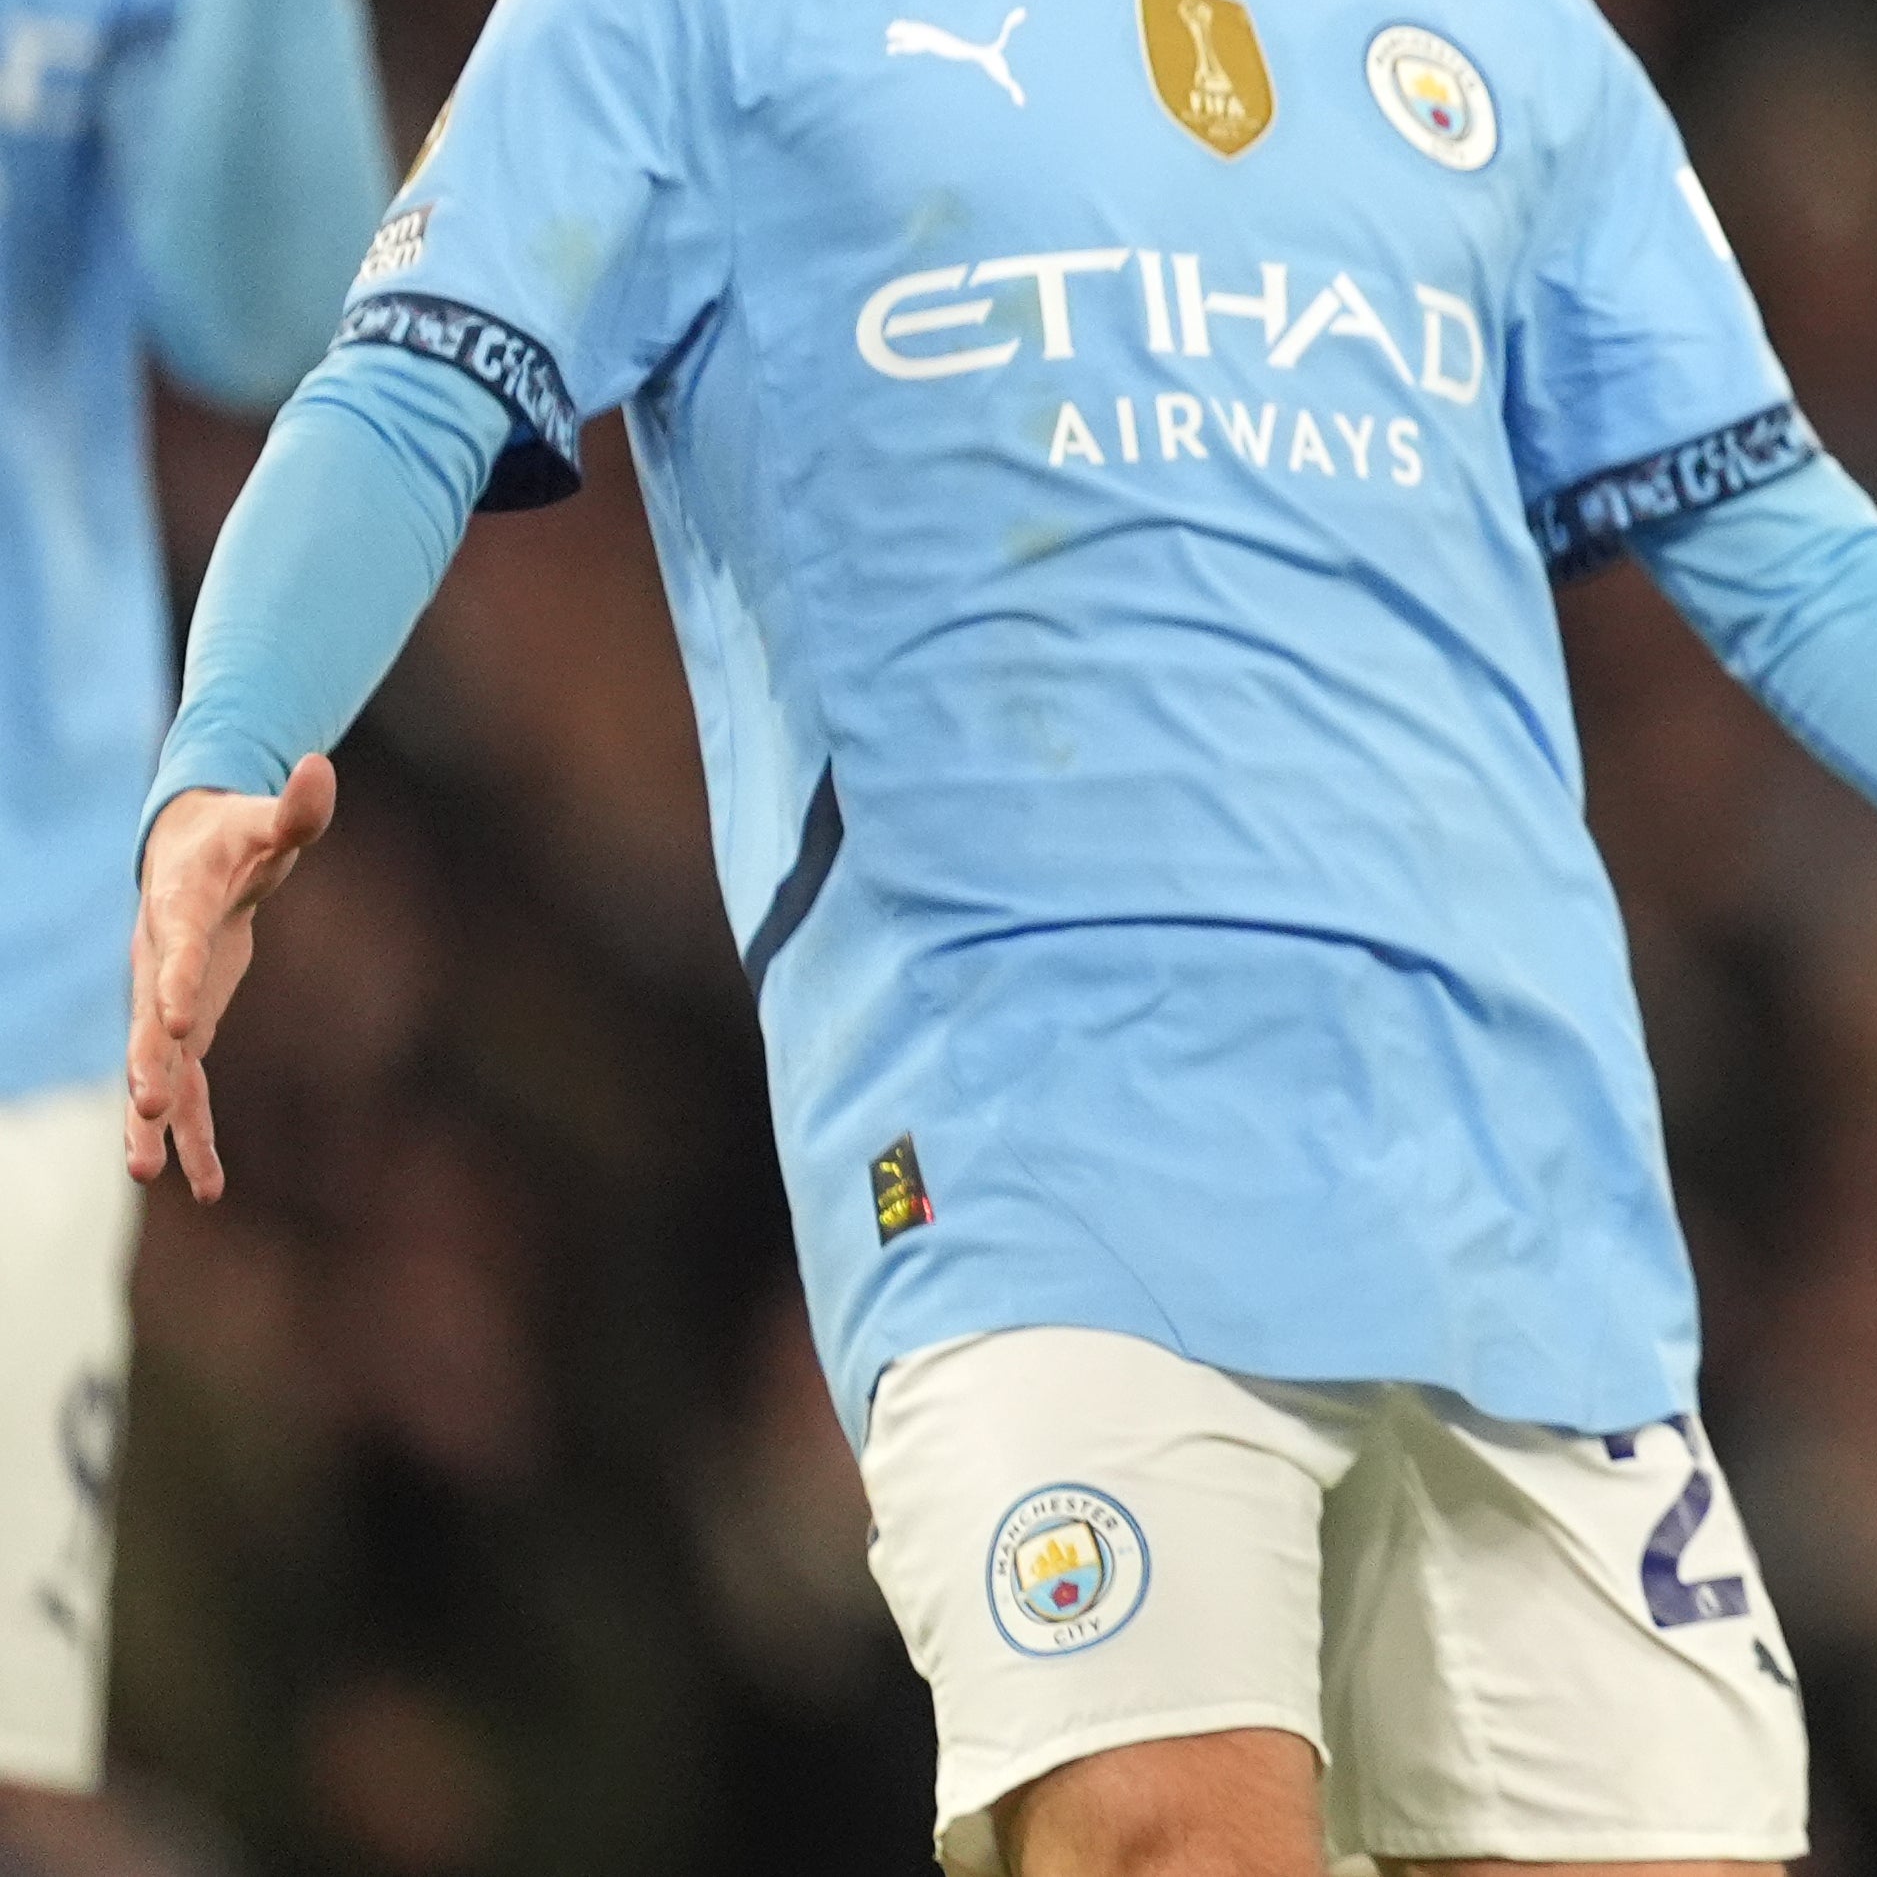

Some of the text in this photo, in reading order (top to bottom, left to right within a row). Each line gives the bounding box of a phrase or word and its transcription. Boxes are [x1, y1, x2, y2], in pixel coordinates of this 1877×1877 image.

[855, 247, 1485, 405] ETIHAD
[1048, 391, 1424, 487] AIRWAYS
[997, 1496, 1119, 1577] MANCHESTER
[1053, 1617, 1100, 1645] CITY
